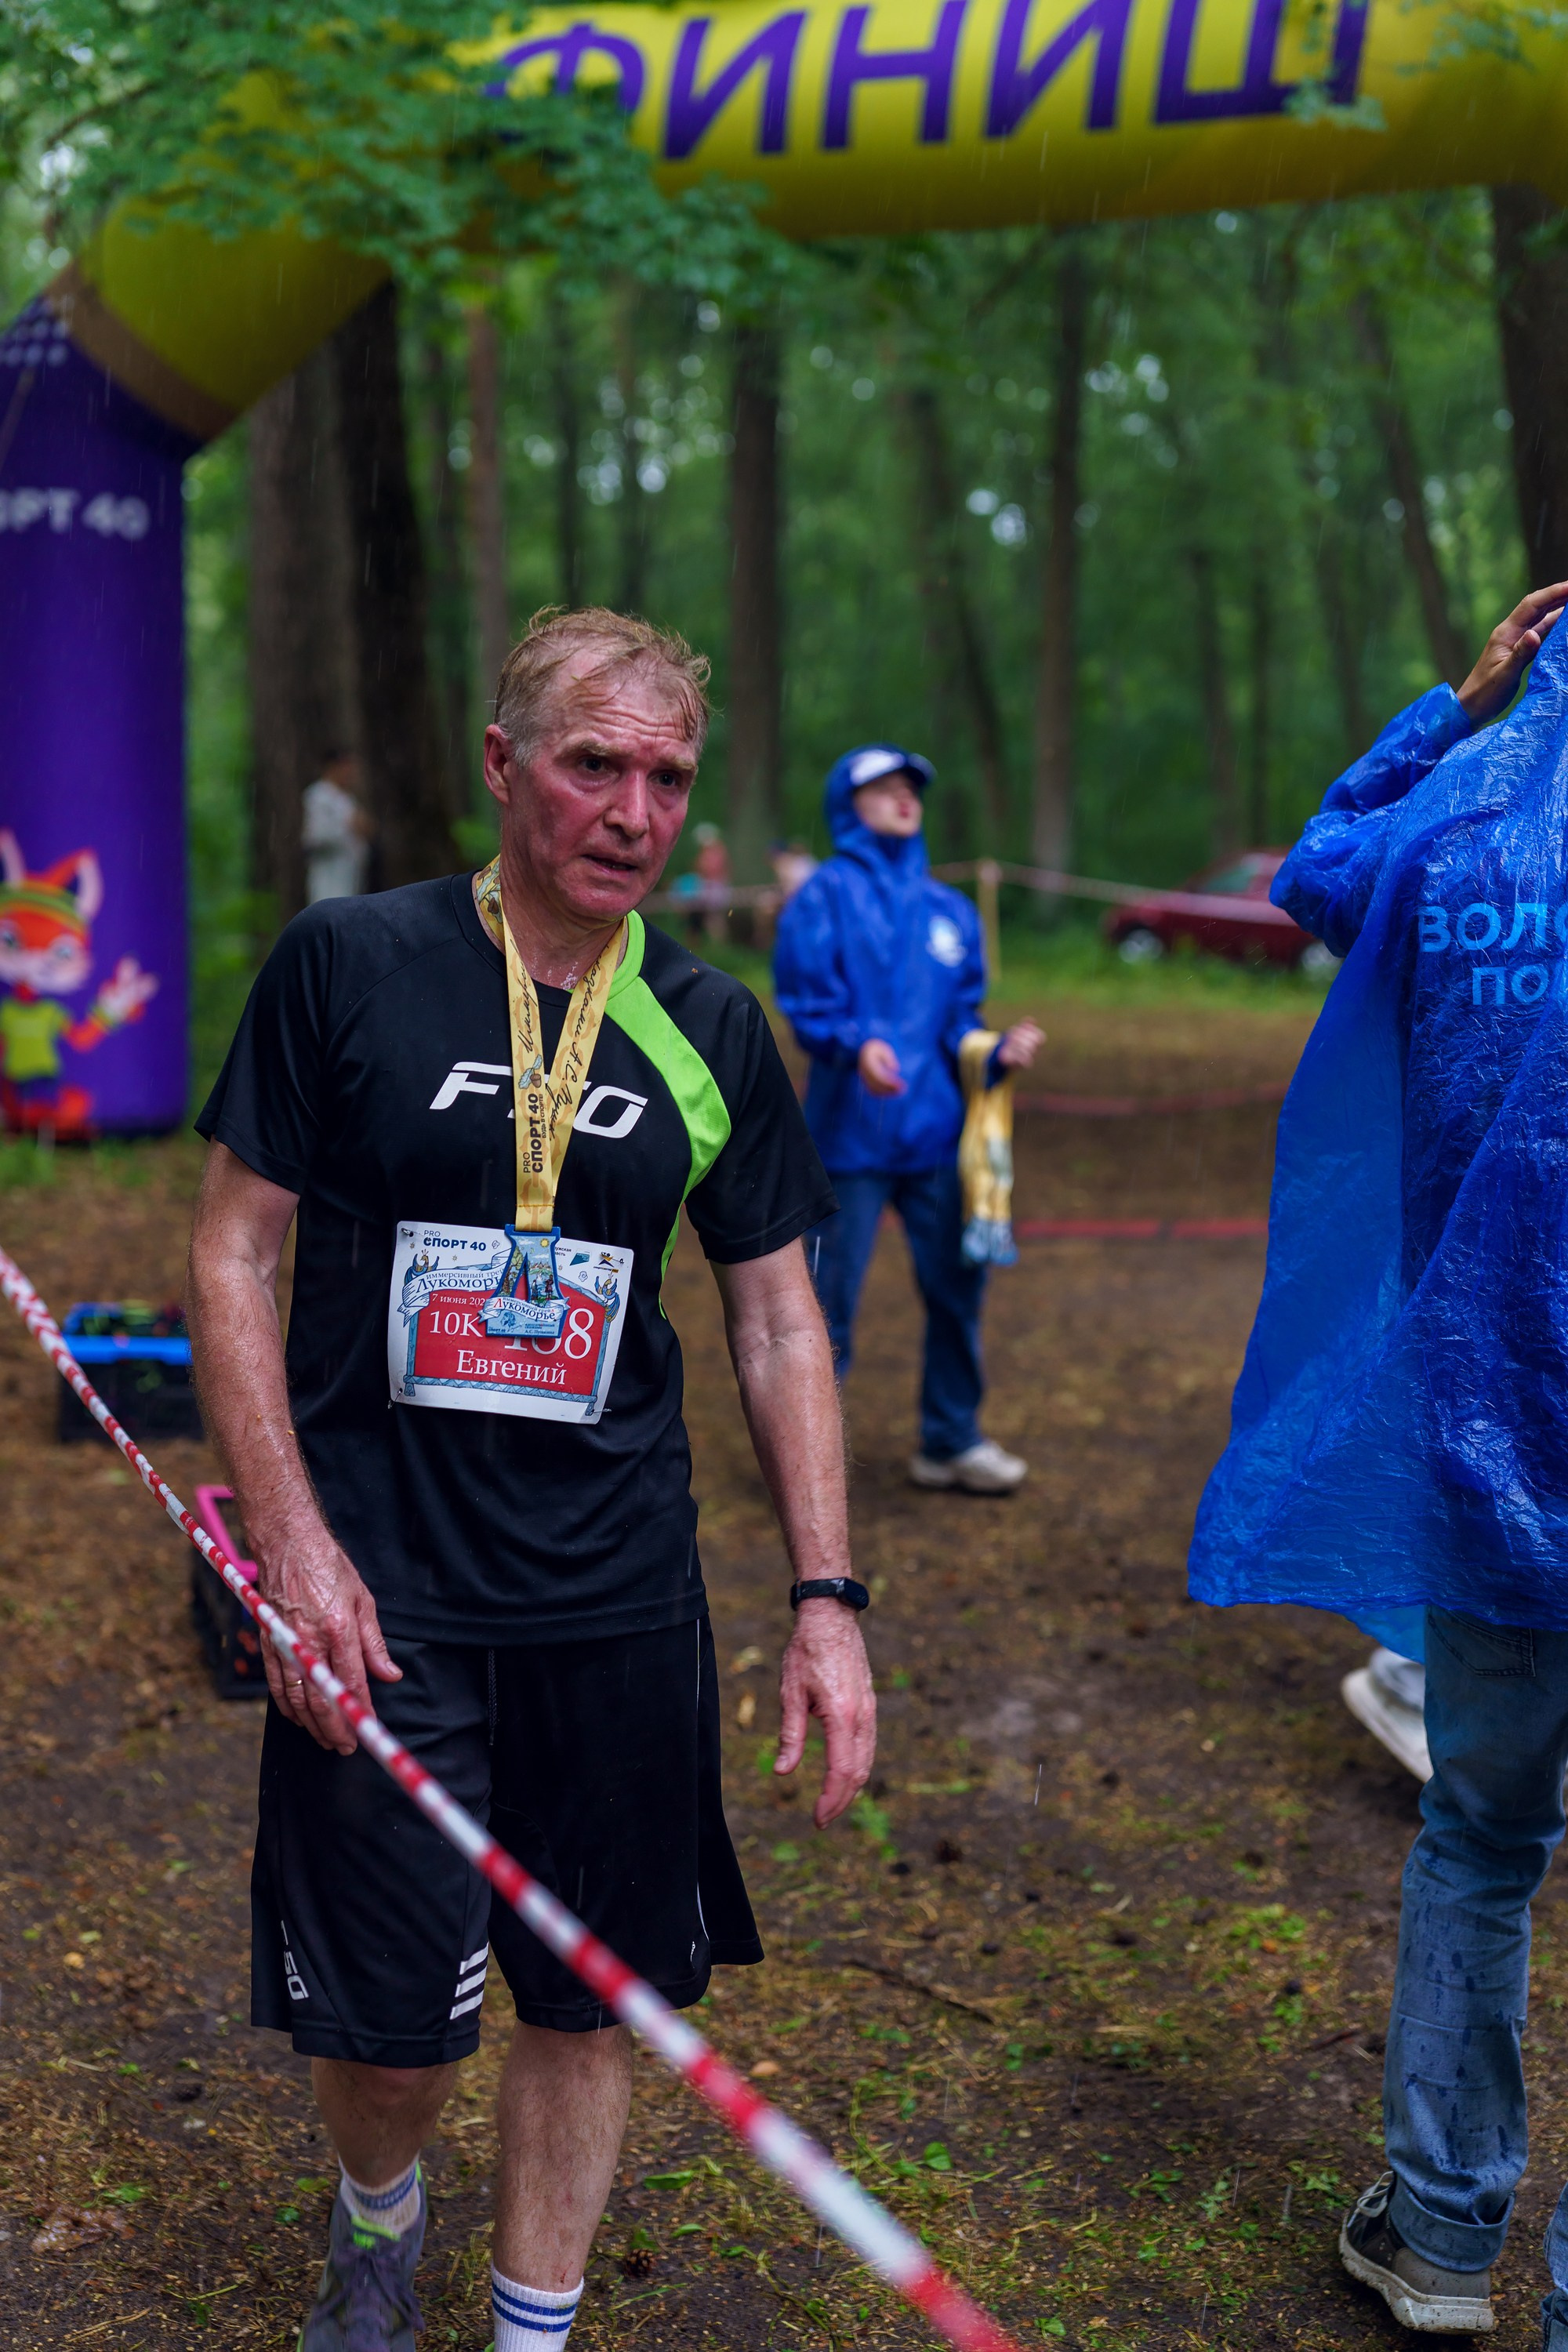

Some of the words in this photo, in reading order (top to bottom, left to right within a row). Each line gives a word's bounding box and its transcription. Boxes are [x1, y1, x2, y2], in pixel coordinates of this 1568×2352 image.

[81, 492, 151, 540] 40
[429, 1061, 649, 1138] FO
[528, 1093, 539, 1114] 40
[529, 1116, 543, 1174] СПОРТ
[522, 1152, 531, 1174] PRO
[423, 1237, 468, 1250] СПОРТ
[470, 1241, 487, 1251] 40
[426, 1272, 484, 1281] иммерсивный
[440, 1296, 467, 1305] июня
[493, 1298, 556, 1321] Лукоморье
[456, 1349, 567, 1385] Евгений
